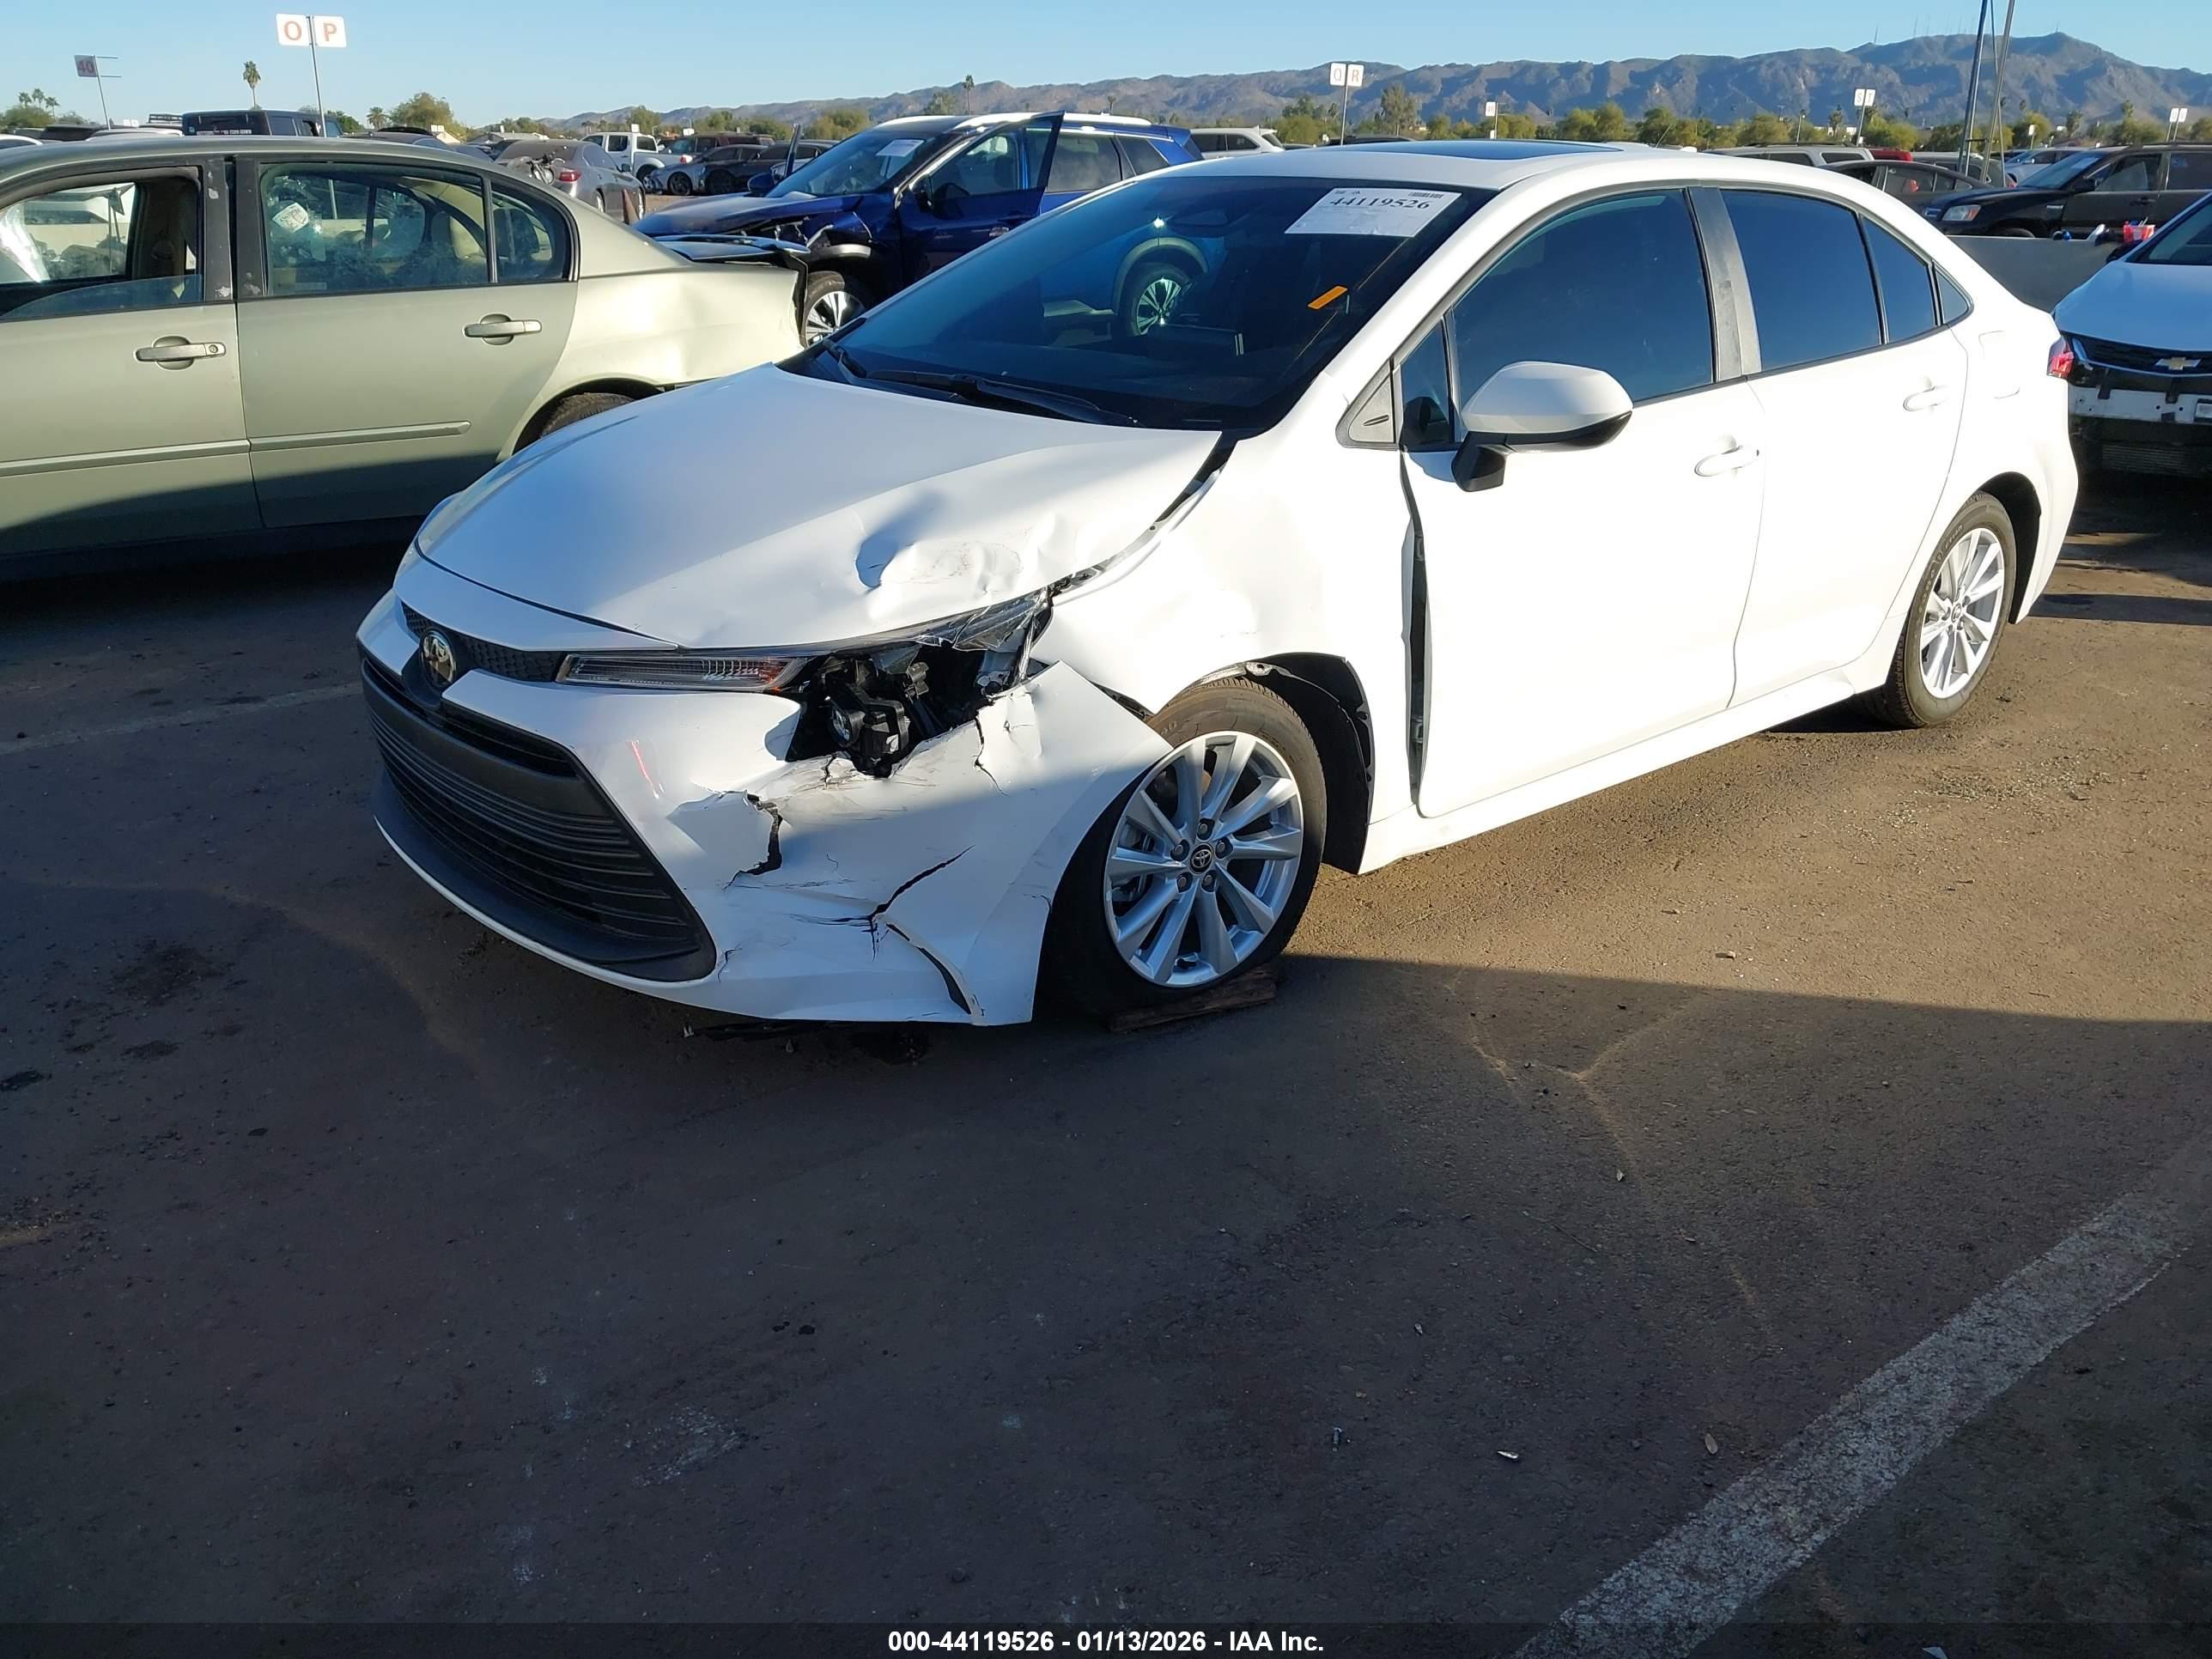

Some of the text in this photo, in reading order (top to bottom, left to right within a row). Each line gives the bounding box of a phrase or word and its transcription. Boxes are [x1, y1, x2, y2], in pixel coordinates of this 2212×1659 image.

[283, 21, 302, 41] O
[323, 22, 337, 42] P
[1352, 69, 1359, 83] R
[1329, 197, 1431, 210] 44119526
